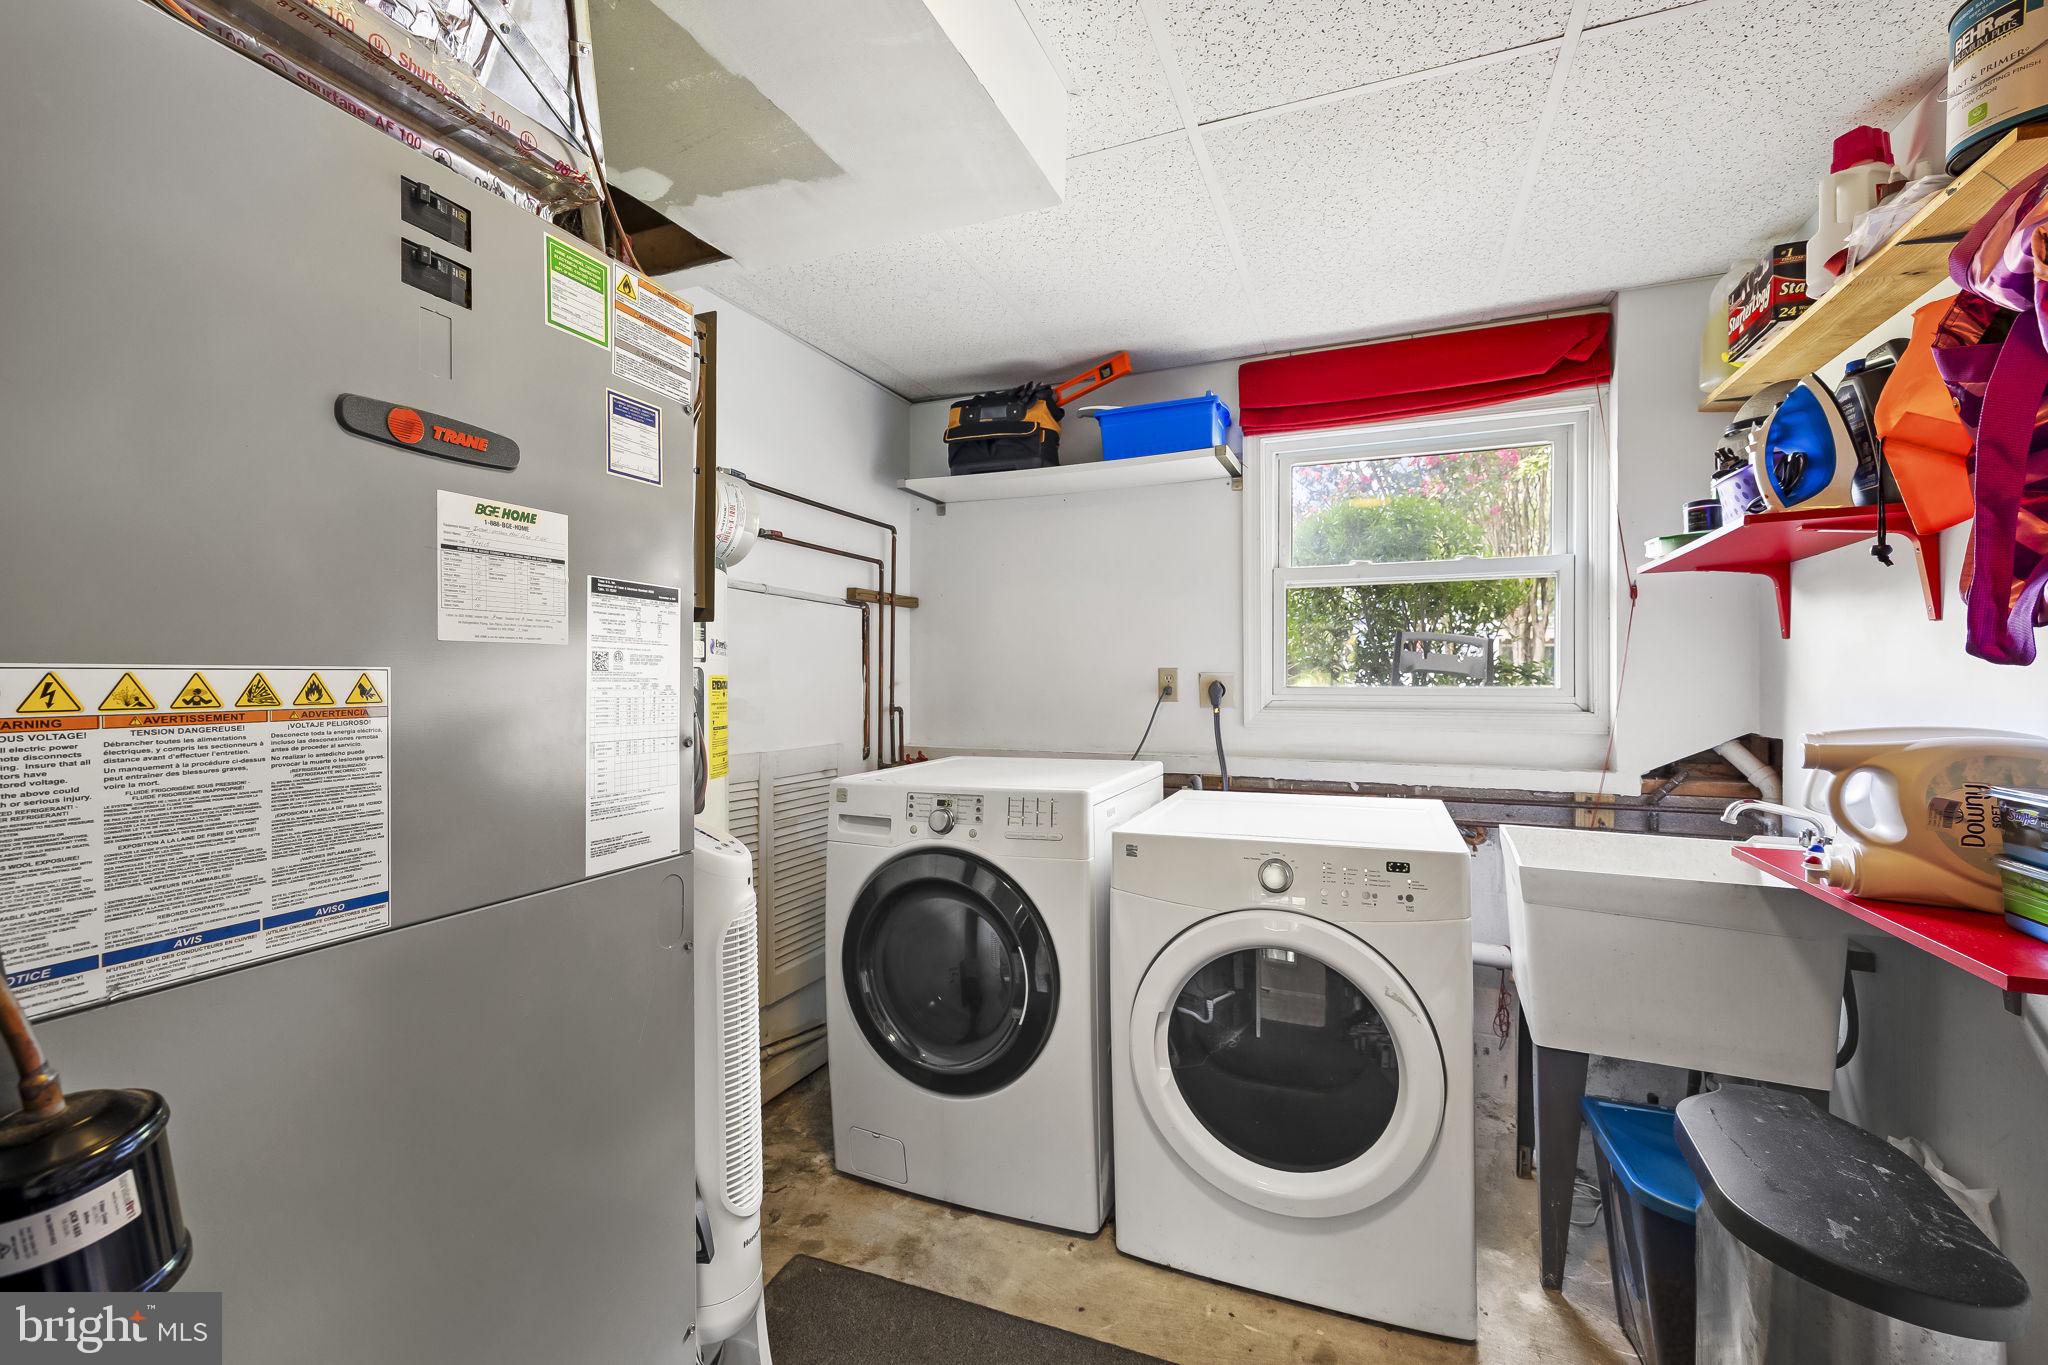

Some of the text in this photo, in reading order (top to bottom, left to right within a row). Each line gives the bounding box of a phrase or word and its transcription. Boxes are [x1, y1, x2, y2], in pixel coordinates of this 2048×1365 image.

[1991, 20, 2017, 38] PLUS
[1955, 16, 1996, 56] BEHR
[1980, 48, 2025, 75] PRIMER
[2013, 59, 2041, 74] FINISH
[491, 111, 510, 132] 100
[375, 112, 396, 133] AF
[399, 128, 421, 150] 100
[1779, 306, 1797, 317] 24
[432, 425, 490, 452] TRANE
[475, 503, 537, 524] BGE HOME
[143, 713, 245, 724] AVERTISSEMENT
[301, 709, 369, 718] ADVERTENCIA
[130, 725, 245, 737] TENSION DANGEREUSE!
[287, 719, 371, 730] ¡VOLTAJE PELIGROSO!
[28, 732, 86, 741] VOLTAGE!
[104, 740, 153, 748] Débrancher
[197, 735, 246, 743] alimentations
[308, 735, 354, 743] desconexiones
[49, 744, 78, 754] power
[163, 745, 195, 753] compris
[23, 752, 81, 761] disconnects
[168, 752, 209, 760] d'effectuer
[118, 764, 173, 772] manquement
[191, 759, 230, 768] procédure
[232, 756, 266, 764] ci-dessus
[103, 775, 123, 783] peut
[126, 772, 163, 780] entraîner
[182, 768, 220, 776] blessures
[222, 766, 248, 774] graves,
[0, 781, 26, 789] tored
[103, 782, 126, 790] voire
[24, 798, 60, 806] serious
[63, 795, 92, 803] injury.
[1961, 783, 1992, 848] Downy
[1991, 804, 2001, 829] SOFT
[118, 841, 159, 850] EXPOSITION
[35, 856, 79, 866] EXPOSURE!
[150, 873, 231, 891] VAPEURS INFLAMMABLES!
[315, 903, 345, 916] AVISO
[173, 935, 202, 949] AVIS
[176, 942, 223, 957] CONDUCTEURS
[7, 968, 51, 986] OTICE
